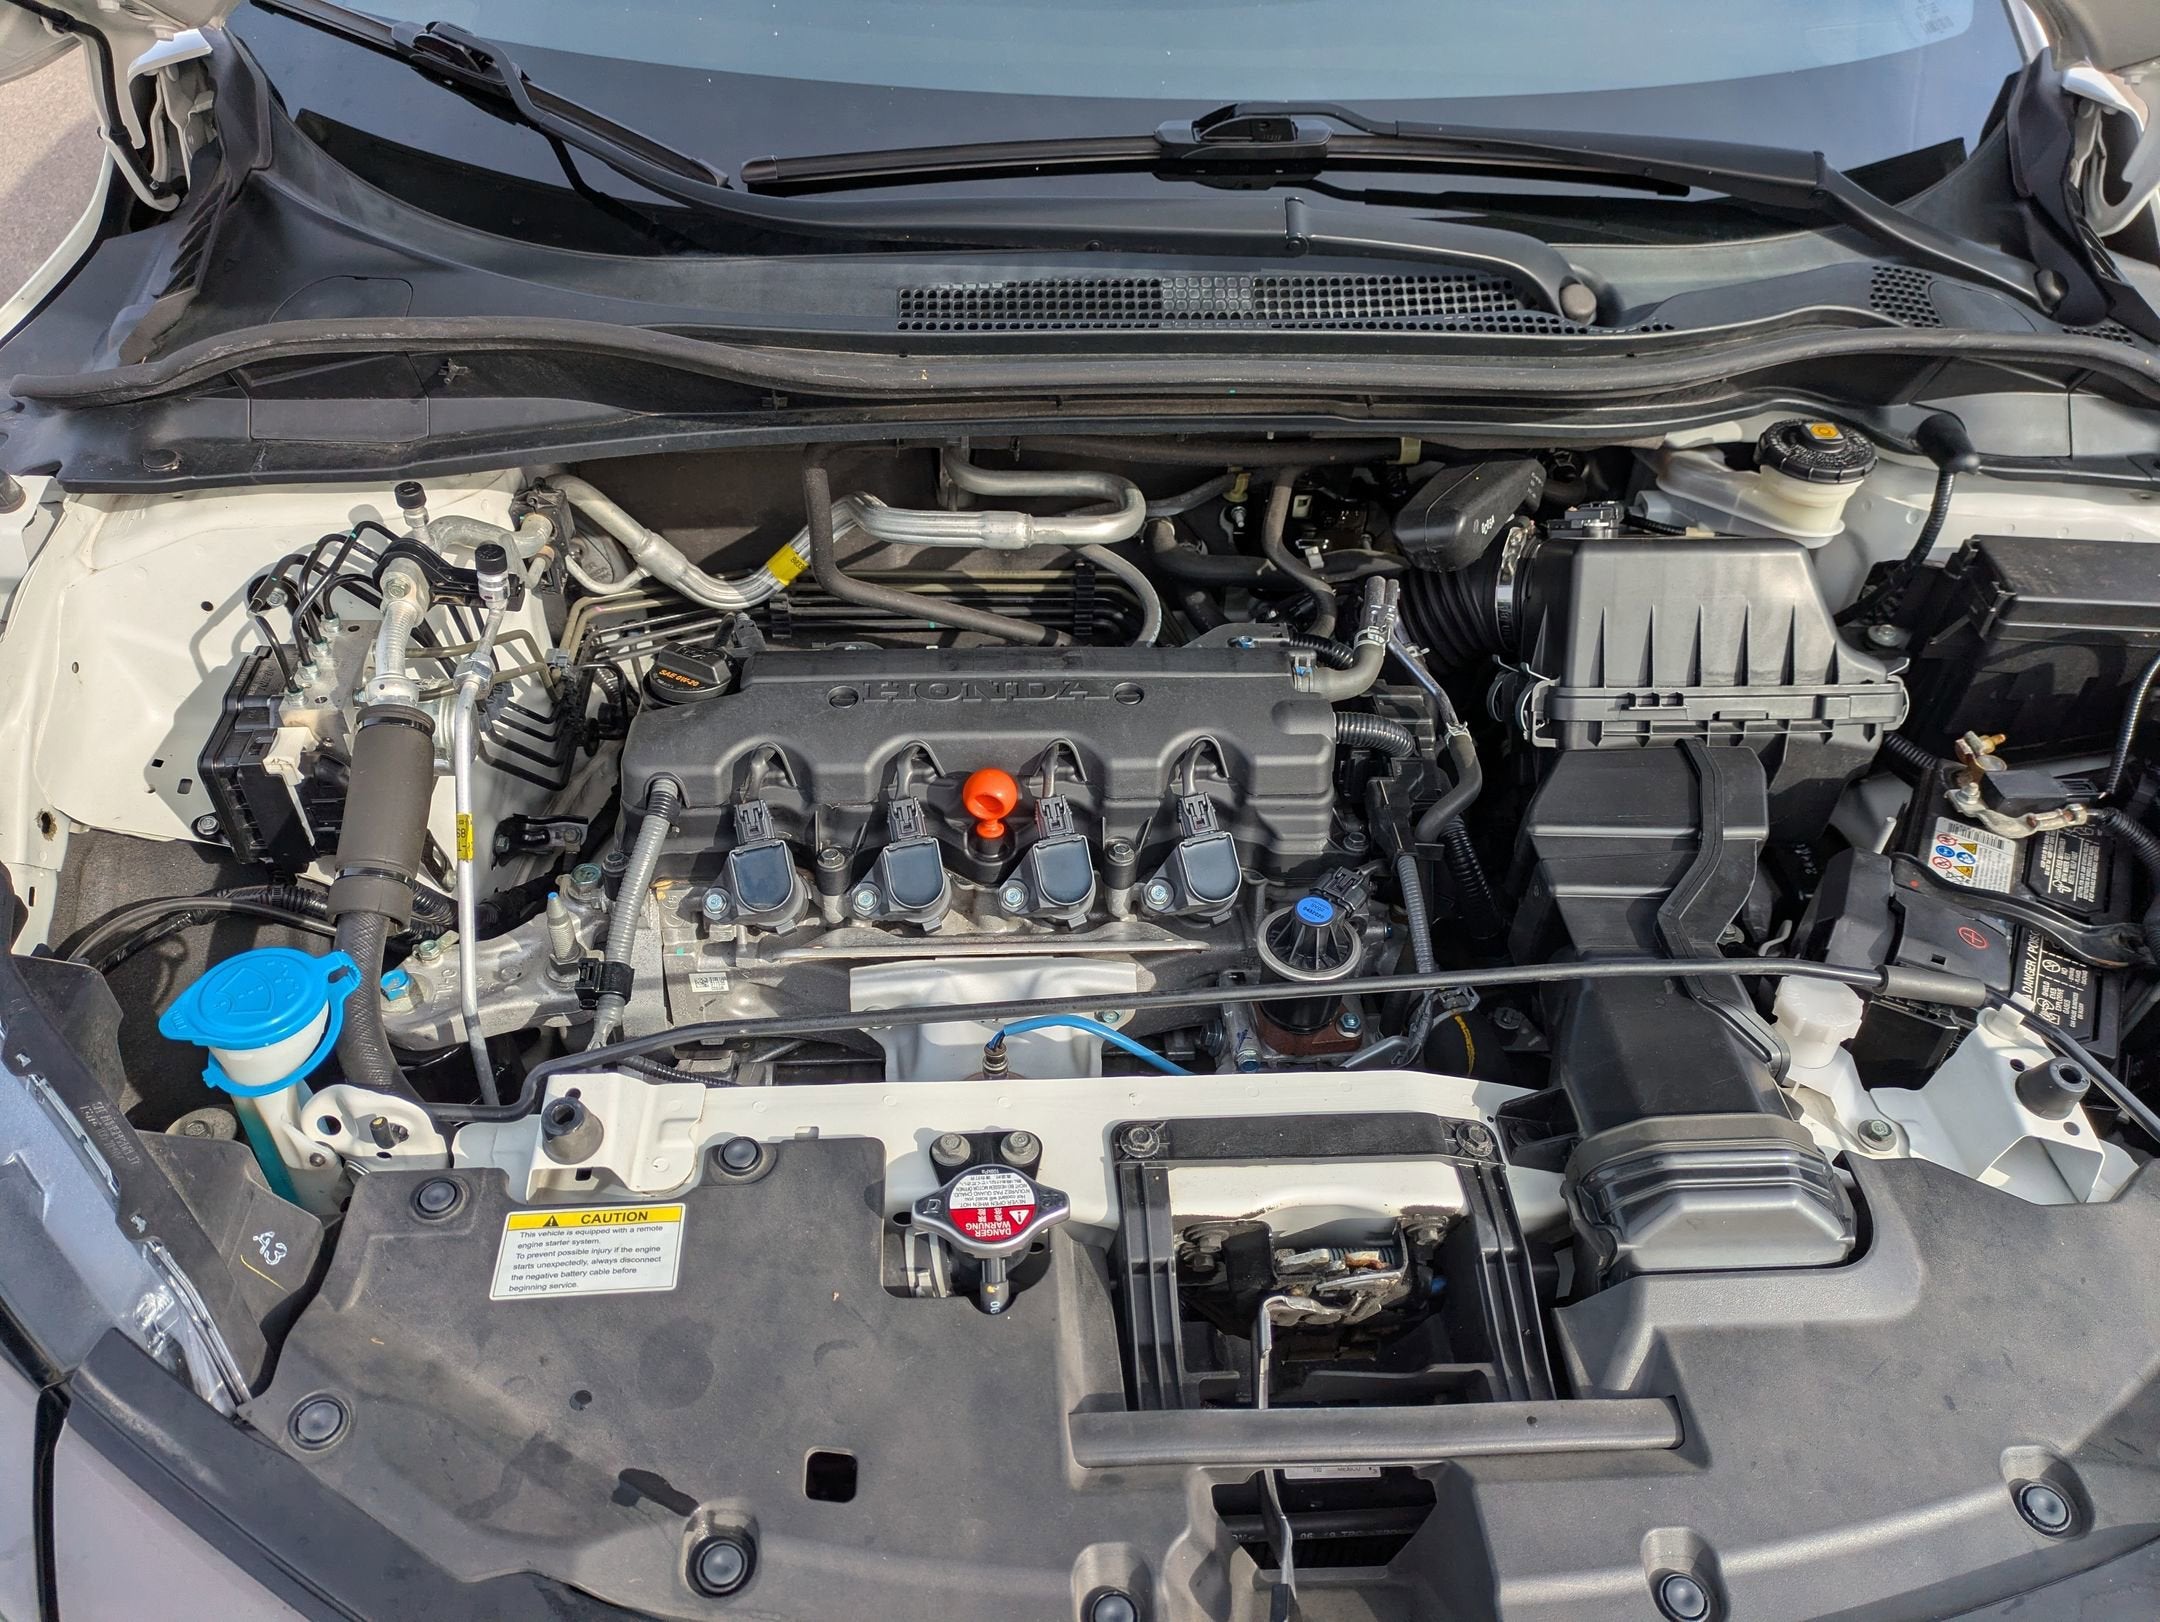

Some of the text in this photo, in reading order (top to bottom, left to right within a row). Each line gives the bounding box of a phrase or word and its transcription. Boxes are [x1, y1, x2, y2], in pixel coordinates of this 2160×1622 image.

[863, 682, 1109, 702] HONDA
[2022, 959, 2036, 994] DANGER
[581, 1211, 648, 1224] CAUTION
[966, 1221, 1011, 1230] WARNUNG
[575, 1228, 610, 1236] equipped
[975, 1228, 1012, 1237] DANGER
[527, 1251, 555, 1260] prevent
[557, 1249, 589, 1257] possible
[635, 1246, 661, 1254] engine
[537, 1259, 589, 1268] unexpectedly,
[591, 1257, 617, 1265] always
[525, 1272, 559, 1280] negative
[589, 1268, 610, 1276] cable
[508, 1284, 547, 1292] beginning
